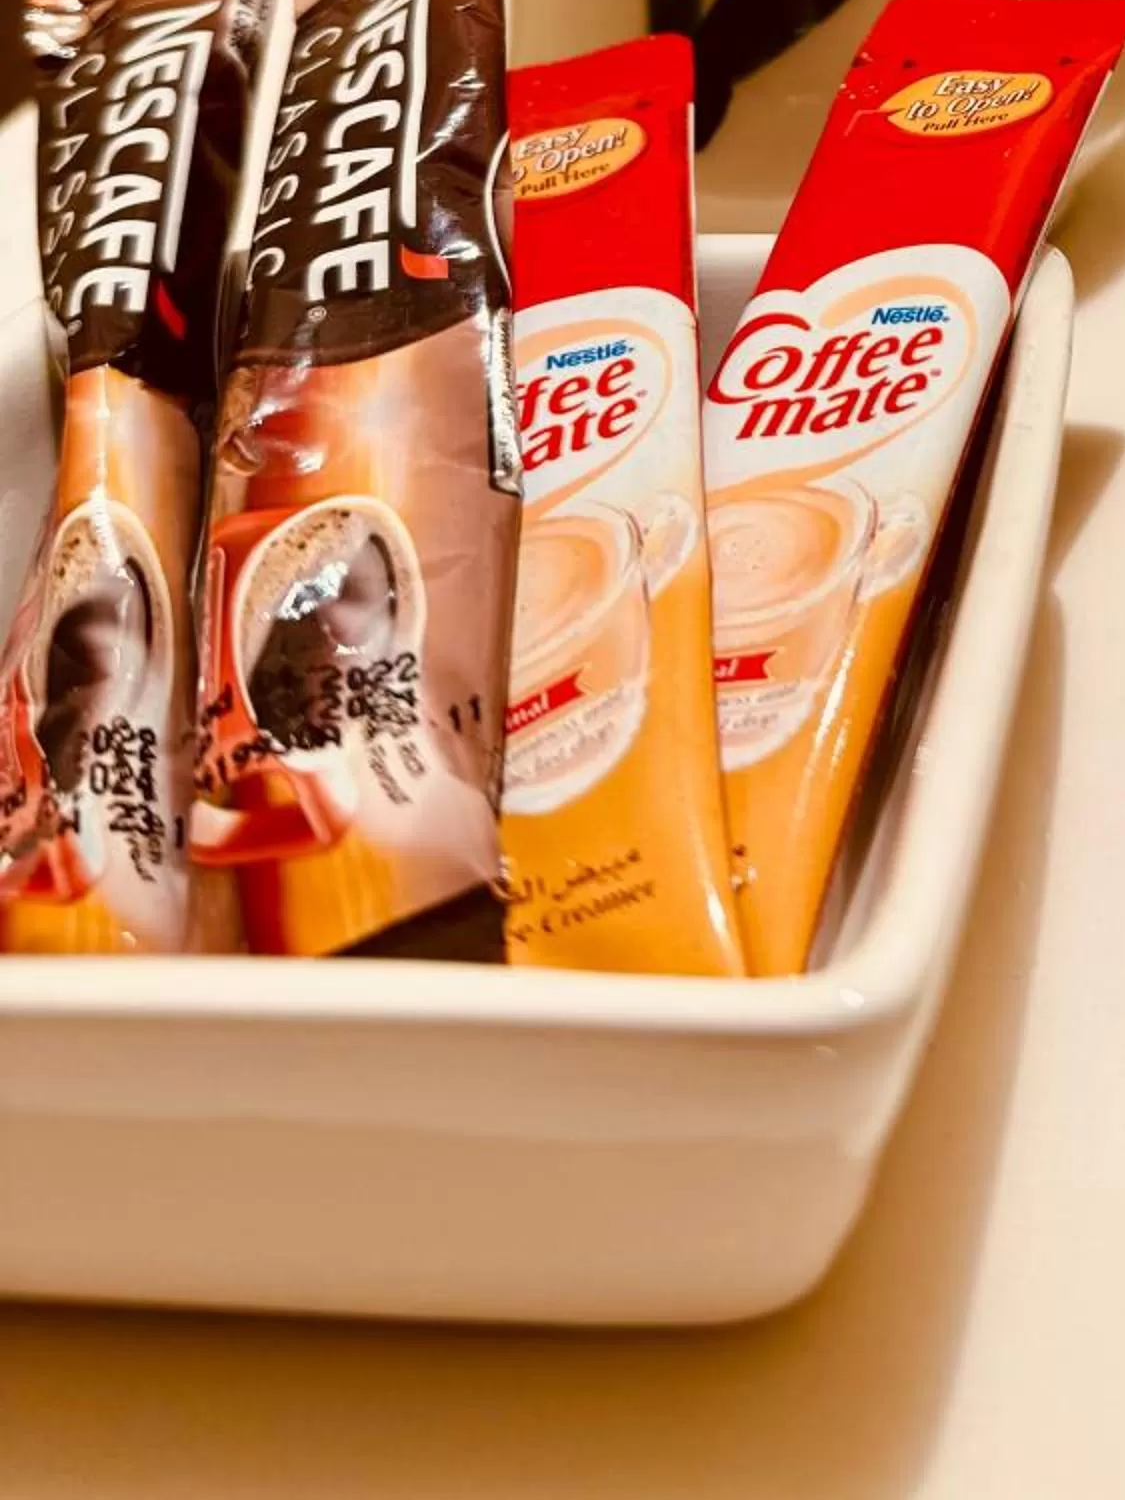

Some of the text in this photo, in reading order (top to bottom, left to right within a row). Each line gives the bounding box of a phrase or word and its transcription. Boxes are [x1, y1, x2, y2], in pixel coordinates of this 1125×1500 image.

[905, 80, 1041, 121] to Open!
[934, 75, 1016, 99] Easy
[515, 123, 591, 160] Easy
[922, 112, 1009, 133] Pull Here
[246, 27, 343, 292] CLASSIC
[535, 125, 628, 174] Open!
[520, 163, 611, 196] Pull Here
[706, 312, 943, 405] Coffee
[515, 357, 635, 432] fee
[735, 372, 928, 441] mate
[520, 397, 638, 472] ate
